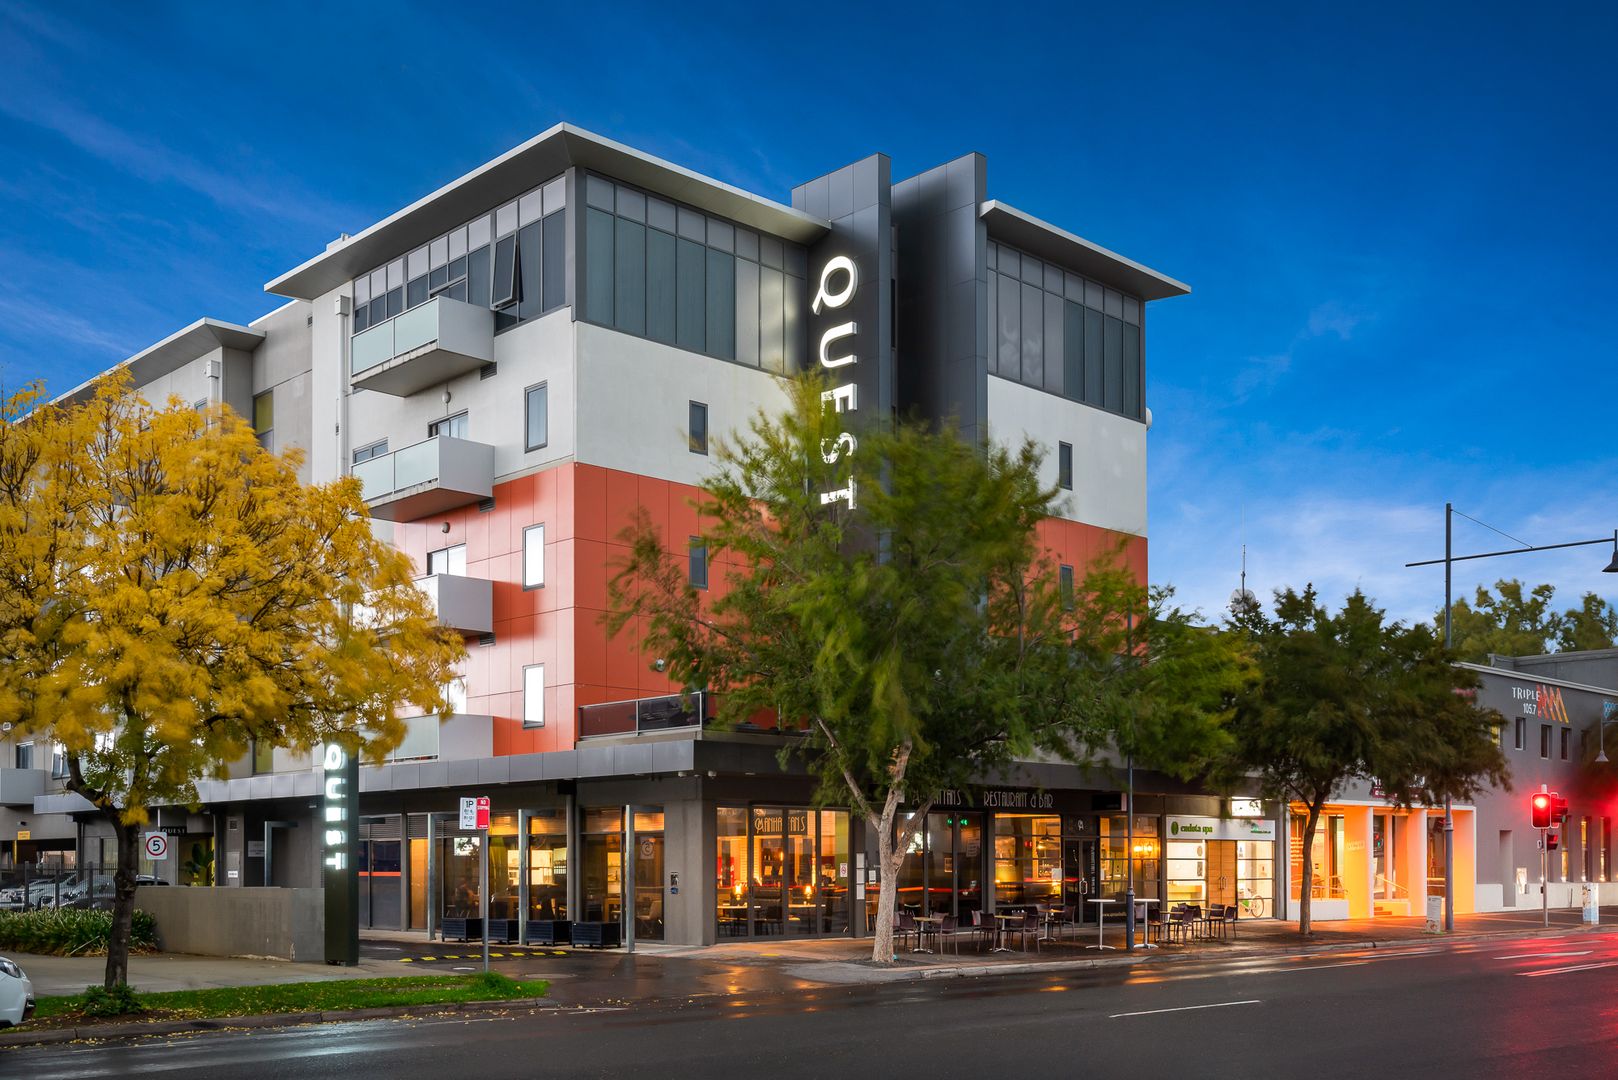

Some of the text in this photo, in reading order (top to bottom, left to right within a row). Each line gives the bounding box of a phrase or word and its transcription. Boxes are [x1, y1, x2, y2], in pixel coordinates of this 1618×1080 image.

[812, 255, 859, 511] QUEST
[1512, 687, 1540, 701] TRIPLE
[465, 800, 474, 808] 1P
[983, 791, 1028, 808] RESTAURANT
[1039, 793, 1054, 809] BAR
[152, 840, 160, 851] 5
